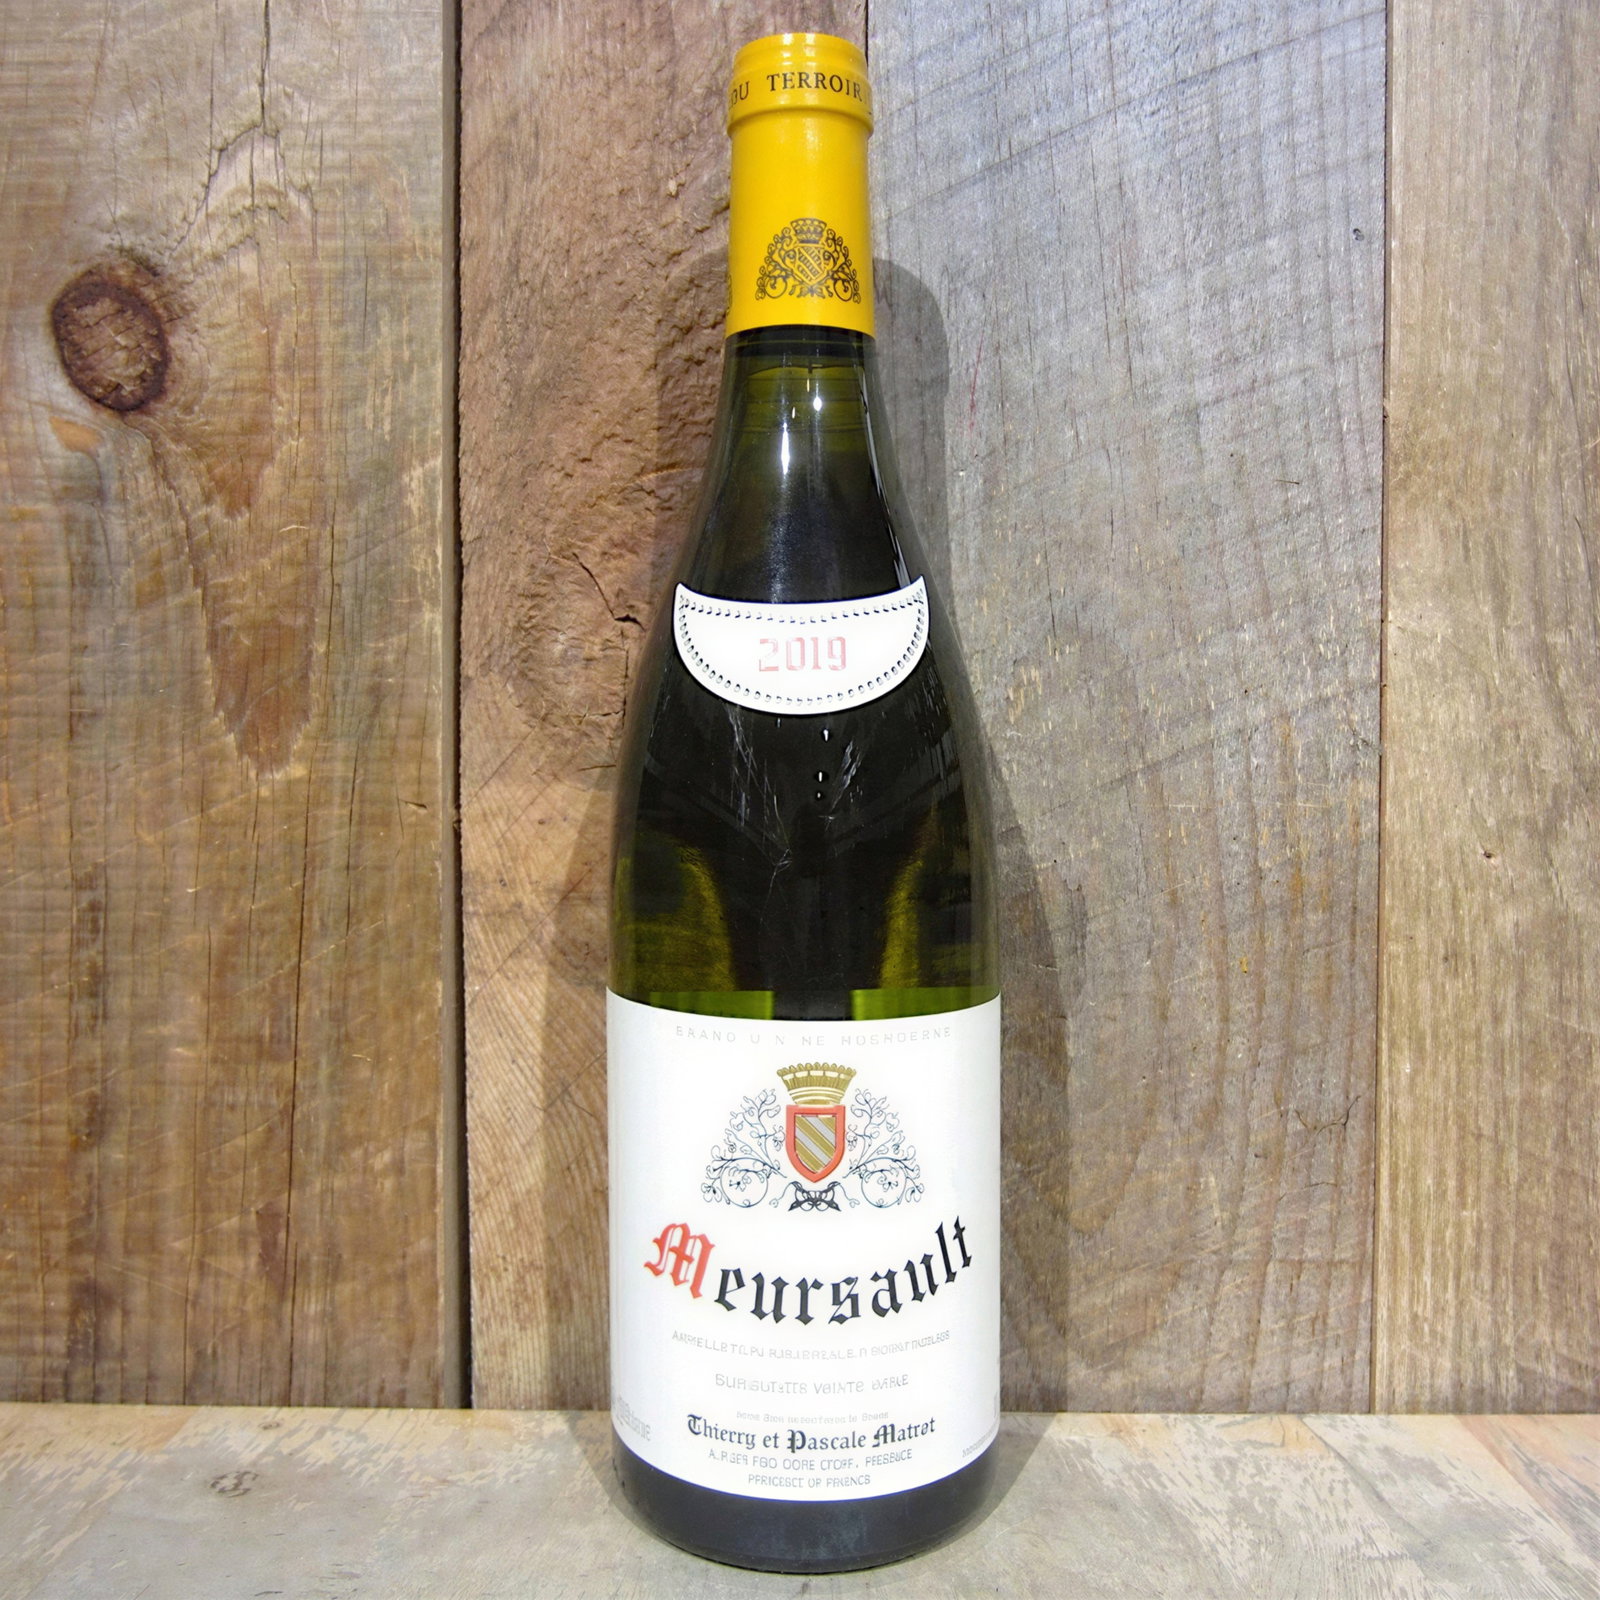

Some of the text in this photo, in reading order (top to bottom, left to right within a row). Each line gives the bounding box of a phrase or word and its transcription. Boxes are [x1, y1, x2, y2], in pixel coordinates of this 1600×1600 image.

[766, 72, 863, 102] TERROIR
[759, 636, 846, 672] 2019
[644, 1215, 972, 1325] Meursault
[687, 1414, 756, 1450] Thierry
[763, 1432, 779, 1449] et
[787, 1429, 866, 1454] Pascale
